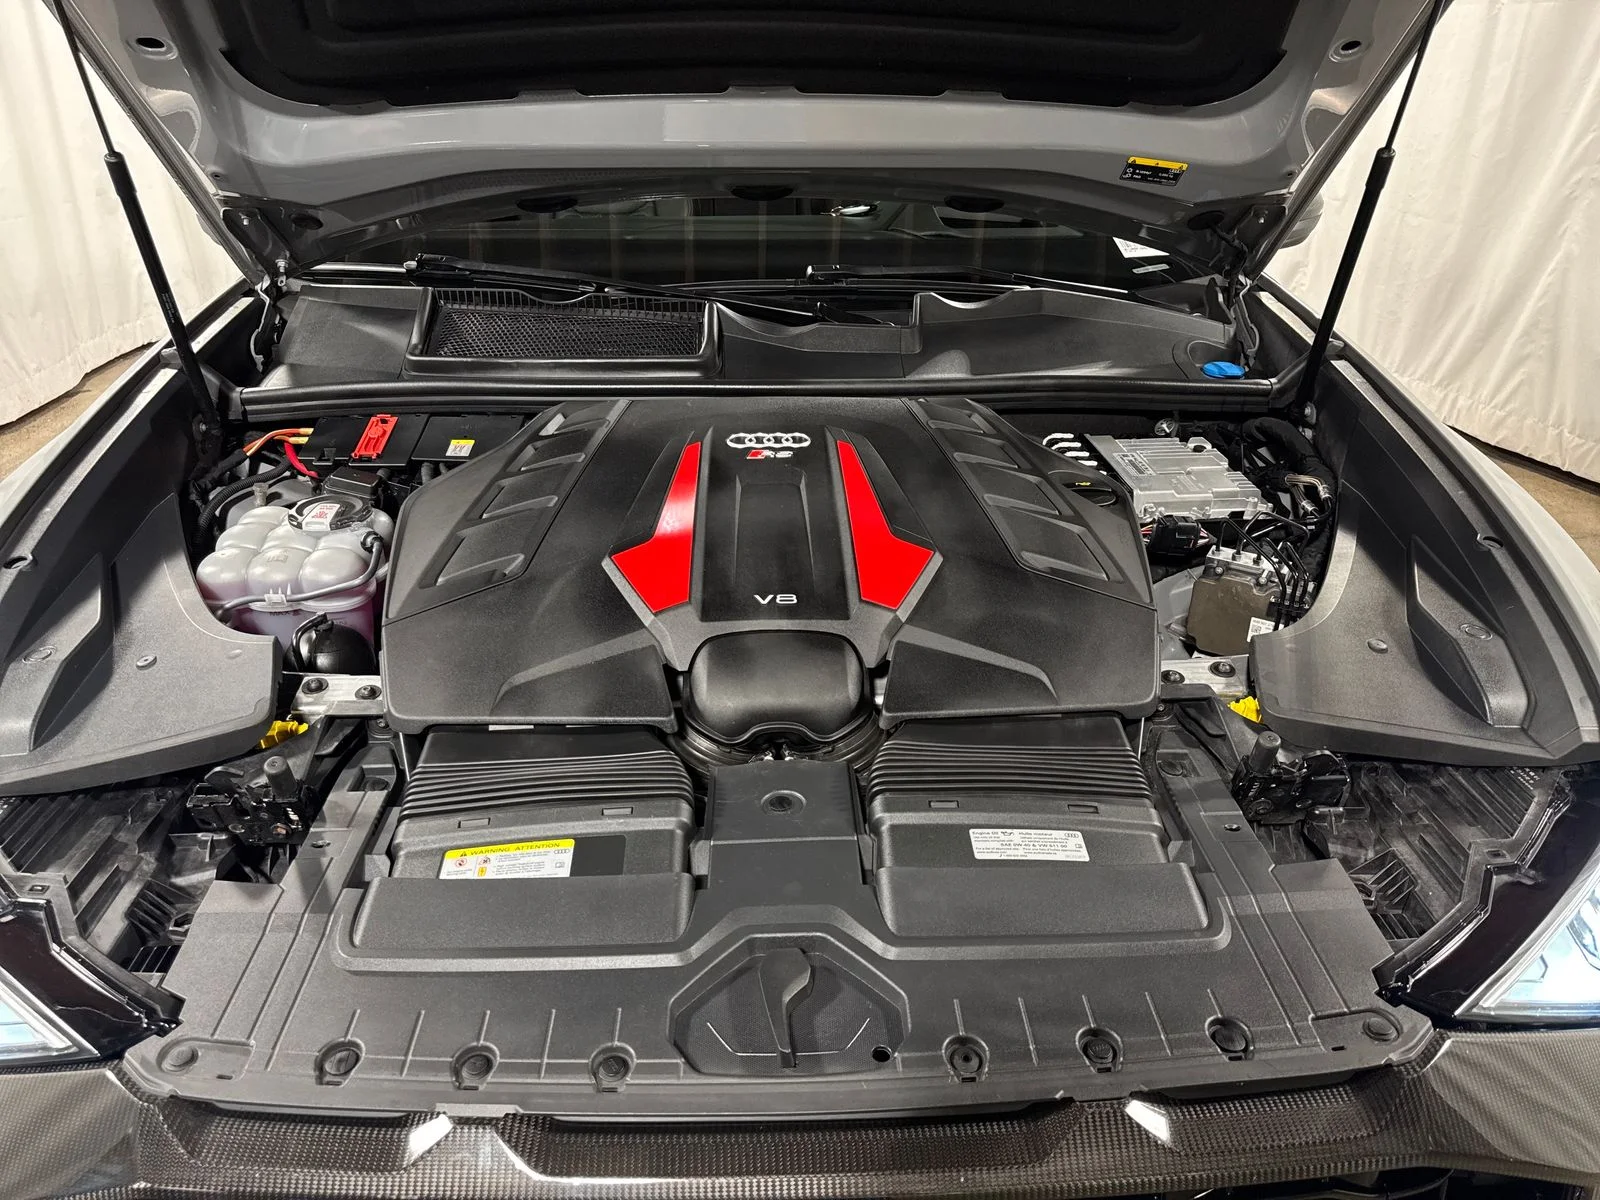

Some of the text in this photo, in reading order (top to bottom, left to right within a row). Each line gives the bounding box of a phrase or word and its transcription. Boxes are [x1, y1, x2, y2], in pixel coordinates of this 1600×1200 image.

[753, 594, 798, 604] V8
[470, 843, 560, 856] WARNING ATTENTION
